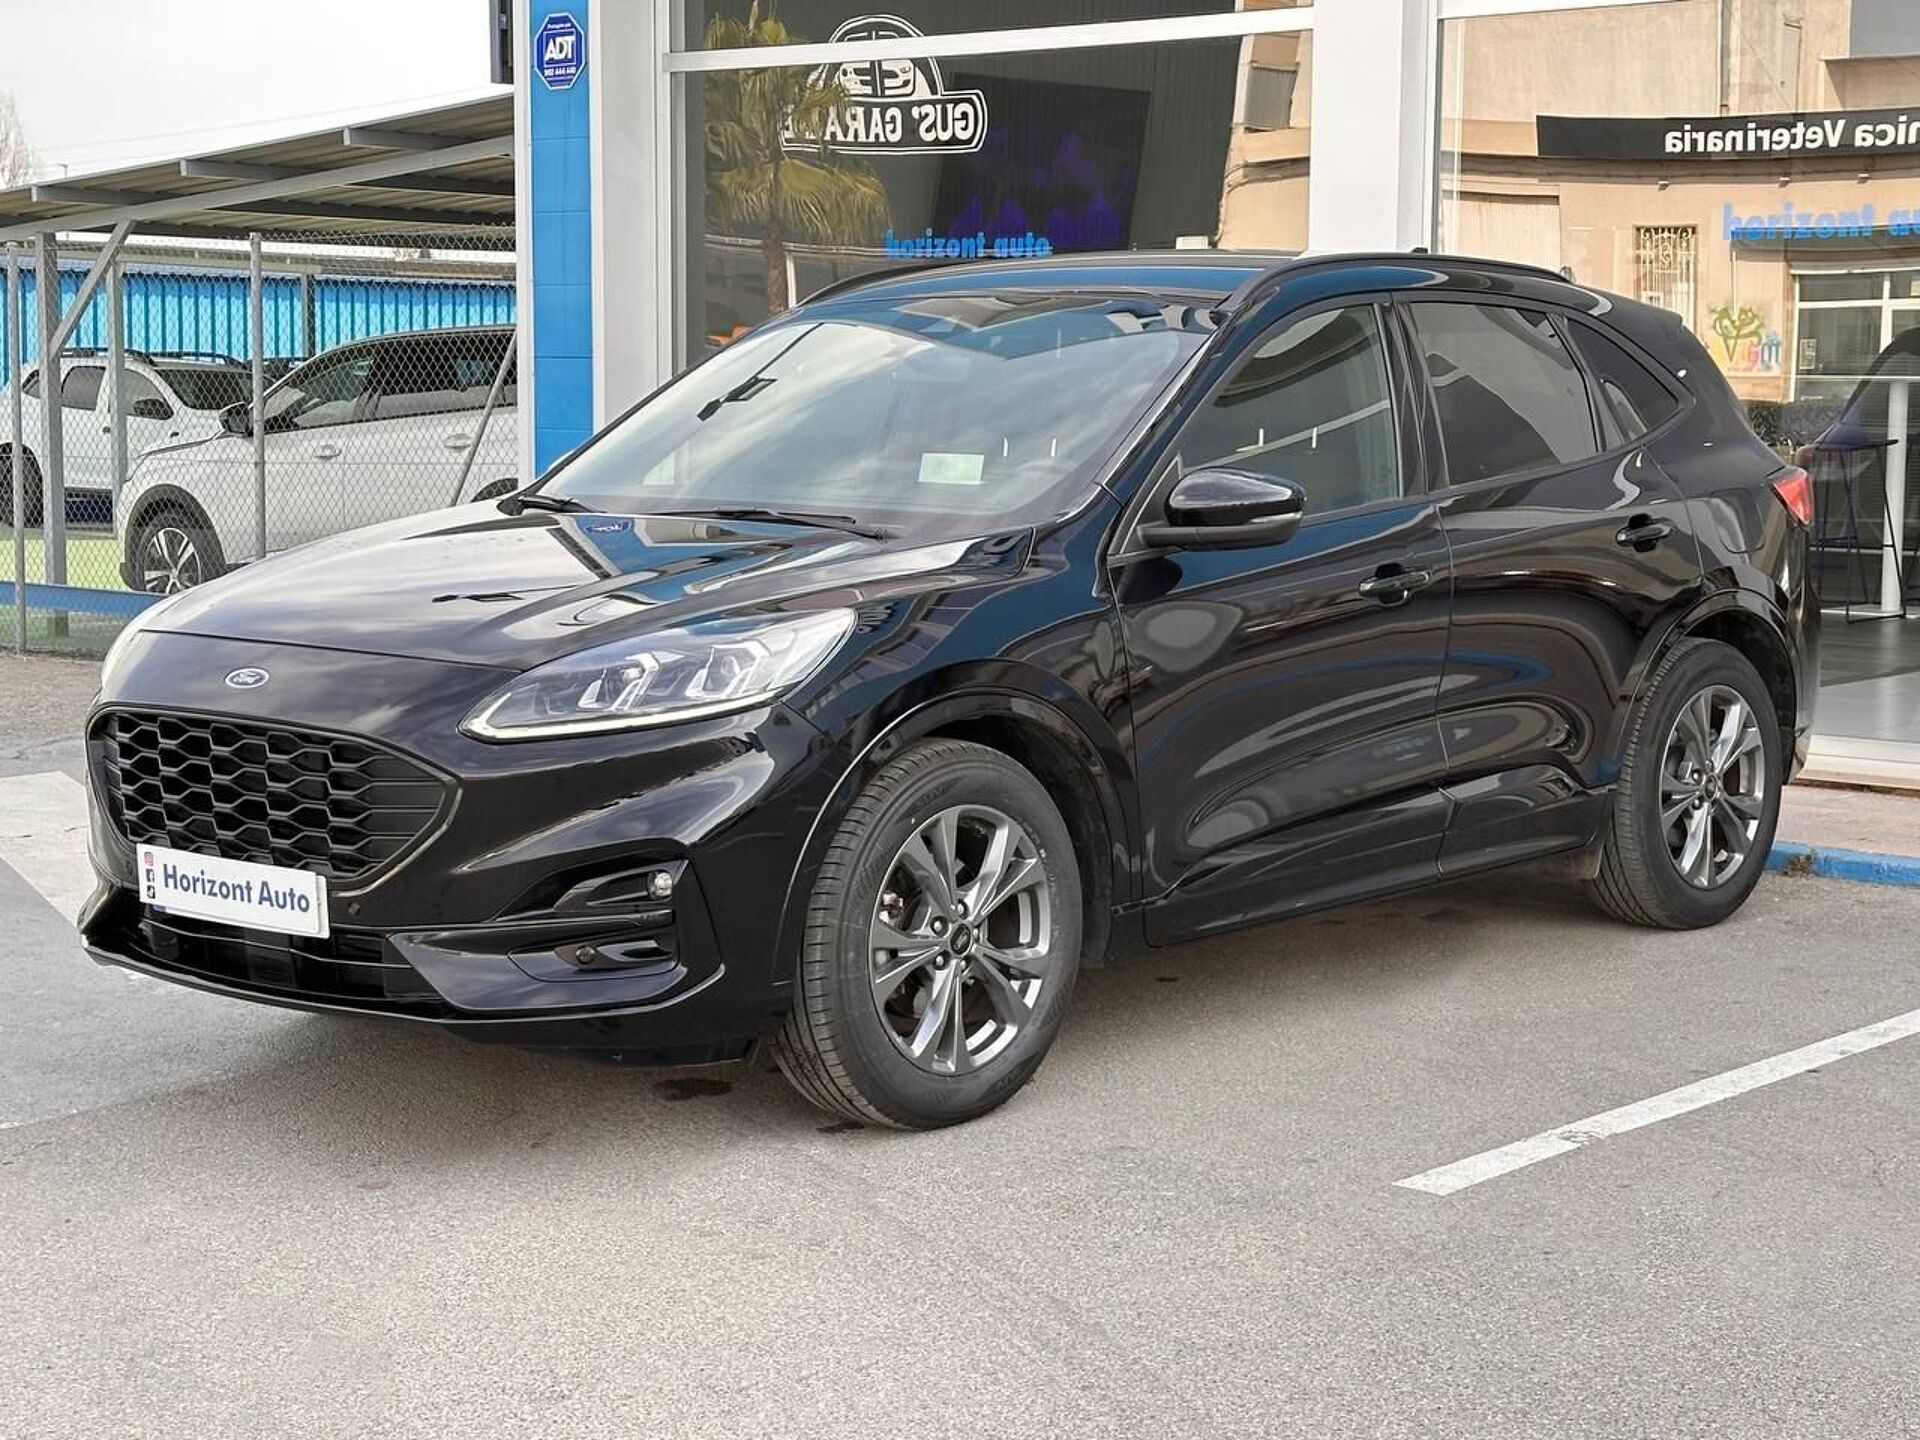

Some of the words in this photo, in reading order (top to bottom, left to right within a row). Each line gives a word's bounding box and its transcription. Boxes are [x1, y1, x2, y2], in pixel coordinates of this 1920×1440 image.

[545, 36, 576, 60] ADT
[1723, 202, 1873, 240] horizont
[886, 228, 986, 259] horizont
[994, 232, 1051, 257] auto
[163, 864, 252, 904] Horizont
[258, 881, 310, 913] Auto
